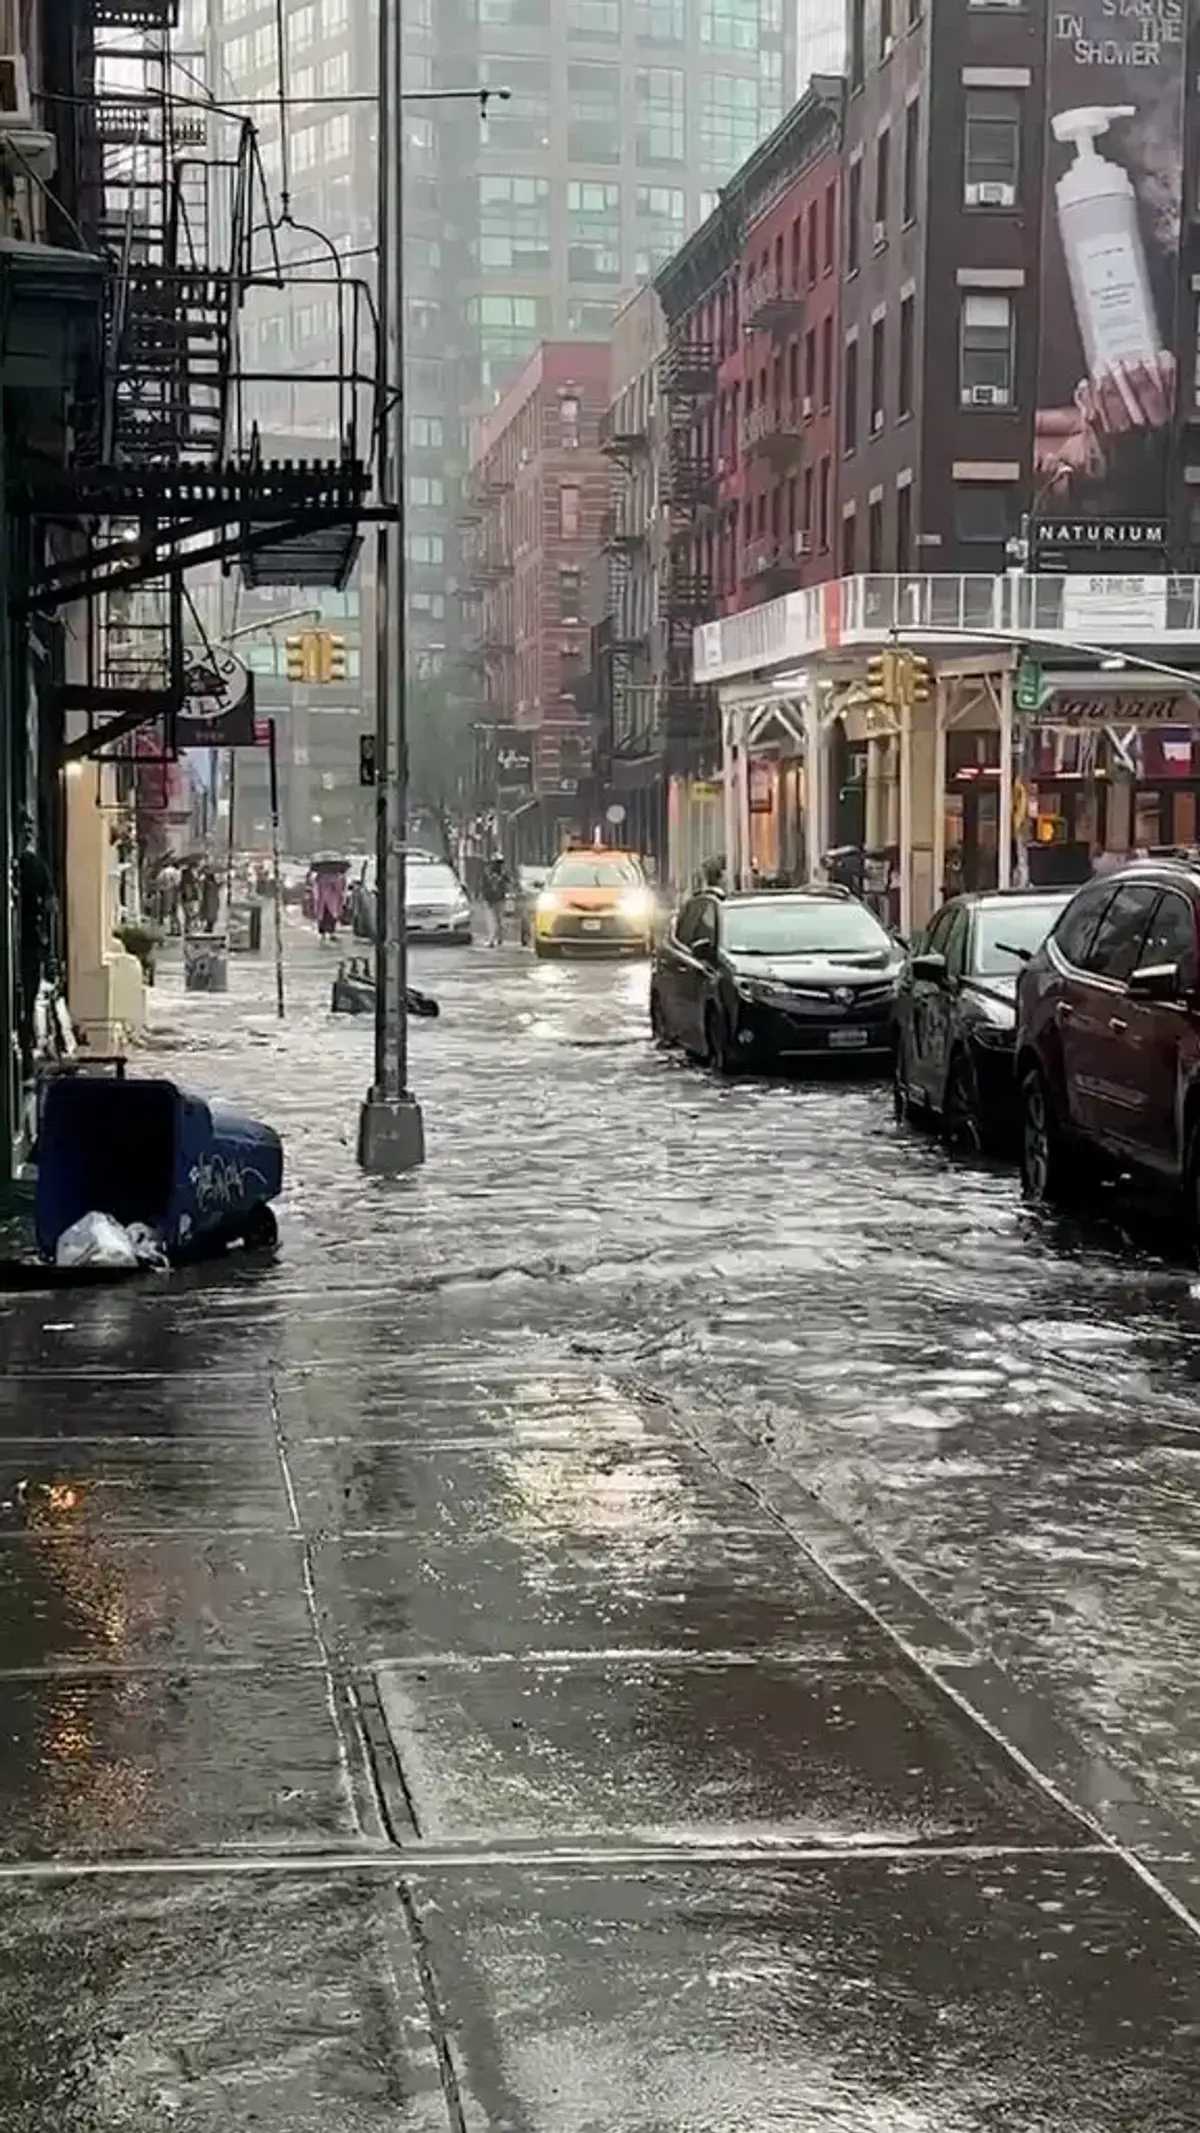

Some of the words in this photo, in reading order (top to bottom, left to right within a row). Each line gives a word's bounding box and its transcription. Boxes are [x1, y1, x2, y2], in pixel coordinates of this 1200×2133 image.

[1102, 0, 1182, 16] STARTS
[1056, 14, 1083, 38] IN
[1140, 18, 1182, 42] THE
[1039, 525, 1162, 541] NATURIUM
